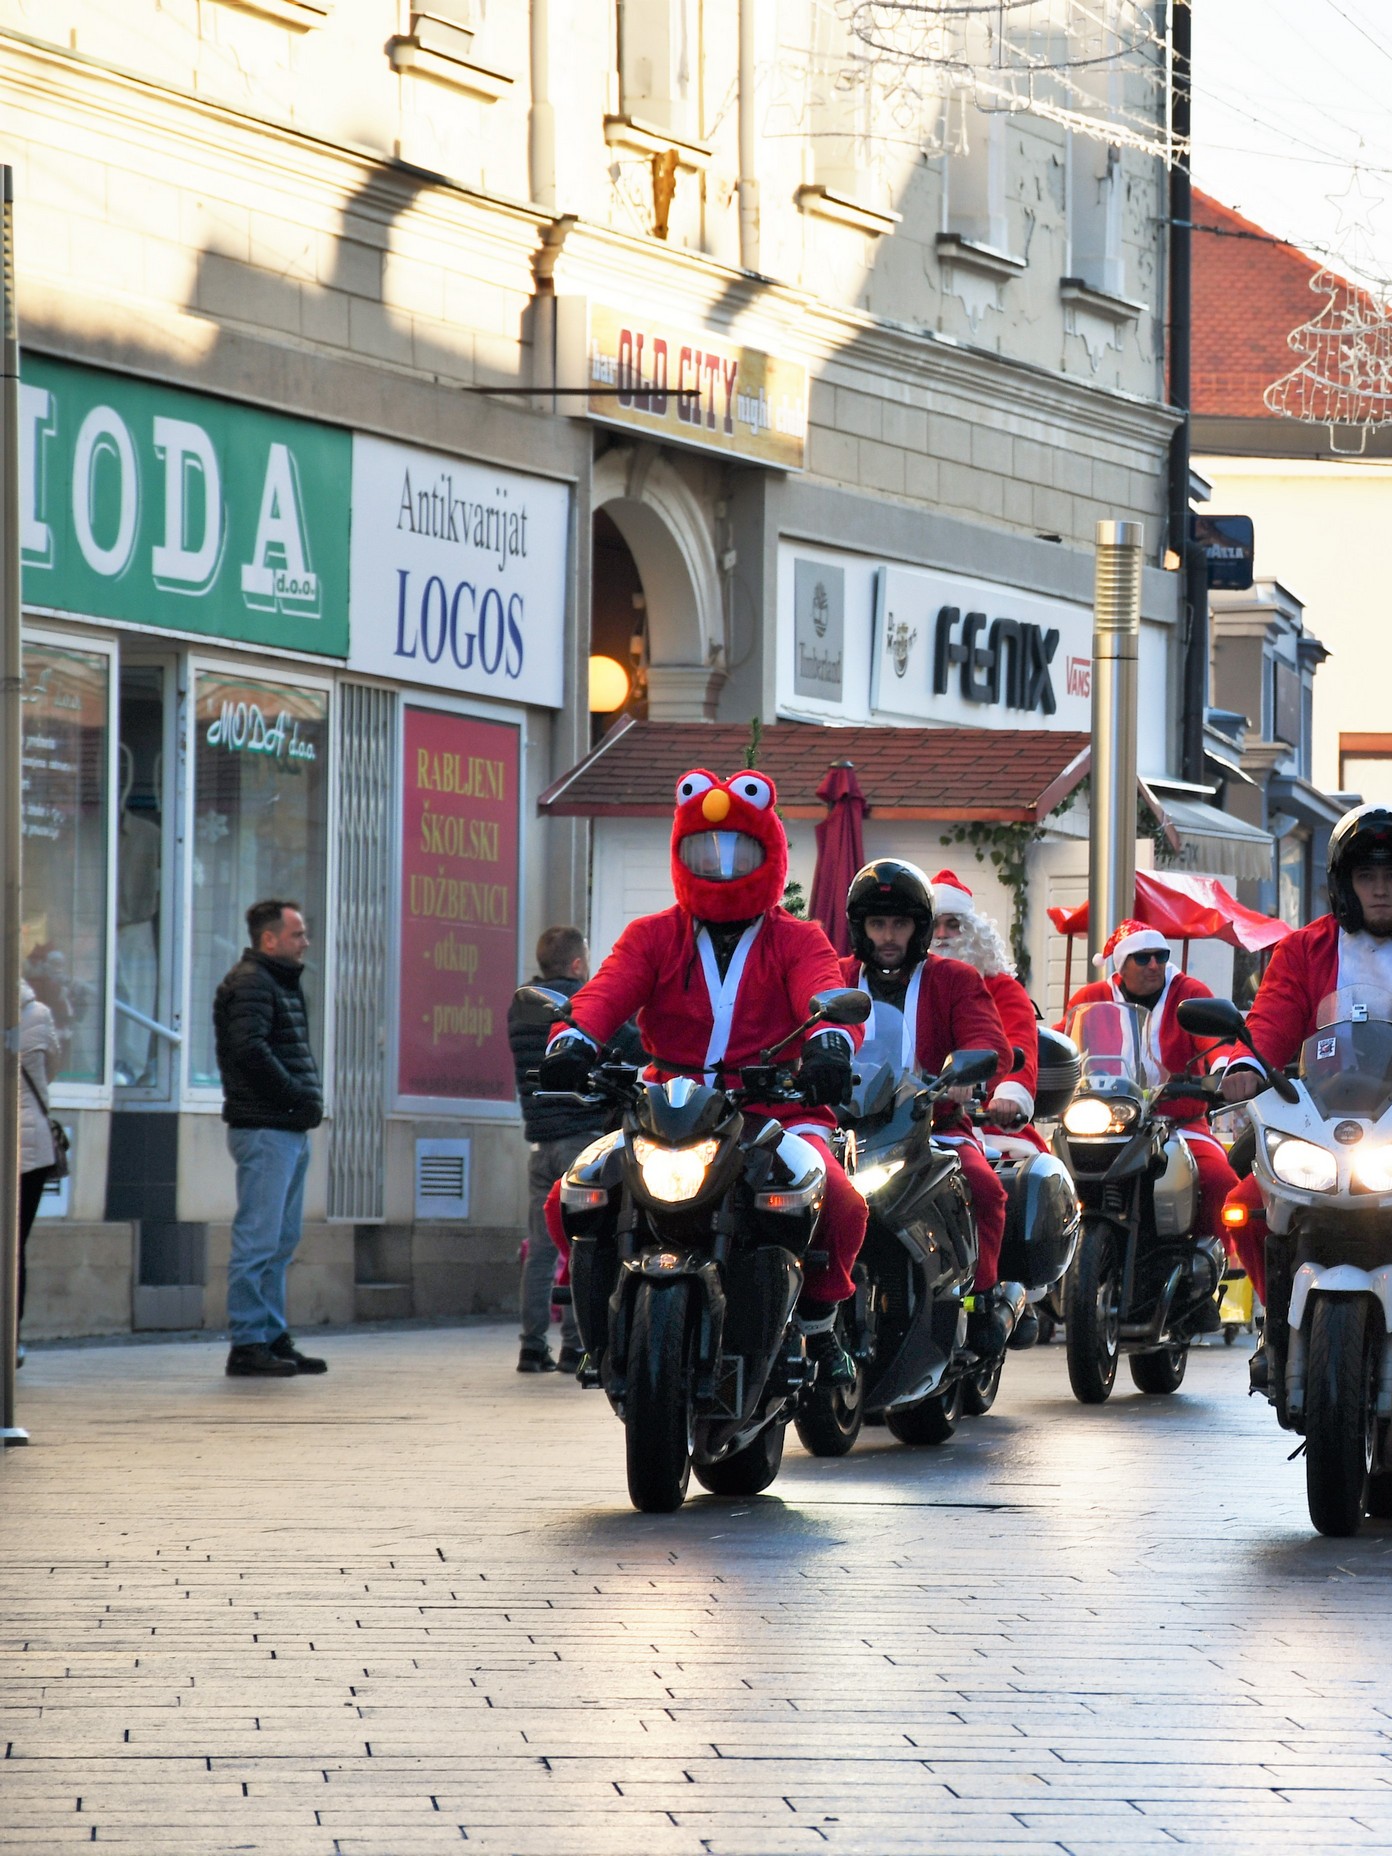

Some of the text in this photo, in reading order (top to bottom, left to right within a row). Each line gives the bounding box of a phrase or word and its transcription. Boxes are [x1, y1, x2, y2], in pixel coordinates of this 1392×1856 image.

[618, 328, 668, 416] OLD
[677, 345, 738, 435] CITY
[396, 465, 528, 573] Antikvarijat
[276, 573, 315, 595] d.o.o.
[393, 568, 524, 680] LOGOS
[933, 605, 1060, 716] FENIX
[1066, 655, 1091, 698] VANS
[416, 748, 504, 801] RABLJENI
[420, 800, 499, 862] ŠKOLSKI
[409, 864, 509, 925] UDŽBENICI
[433, 995, 494, 1047] prodaja
